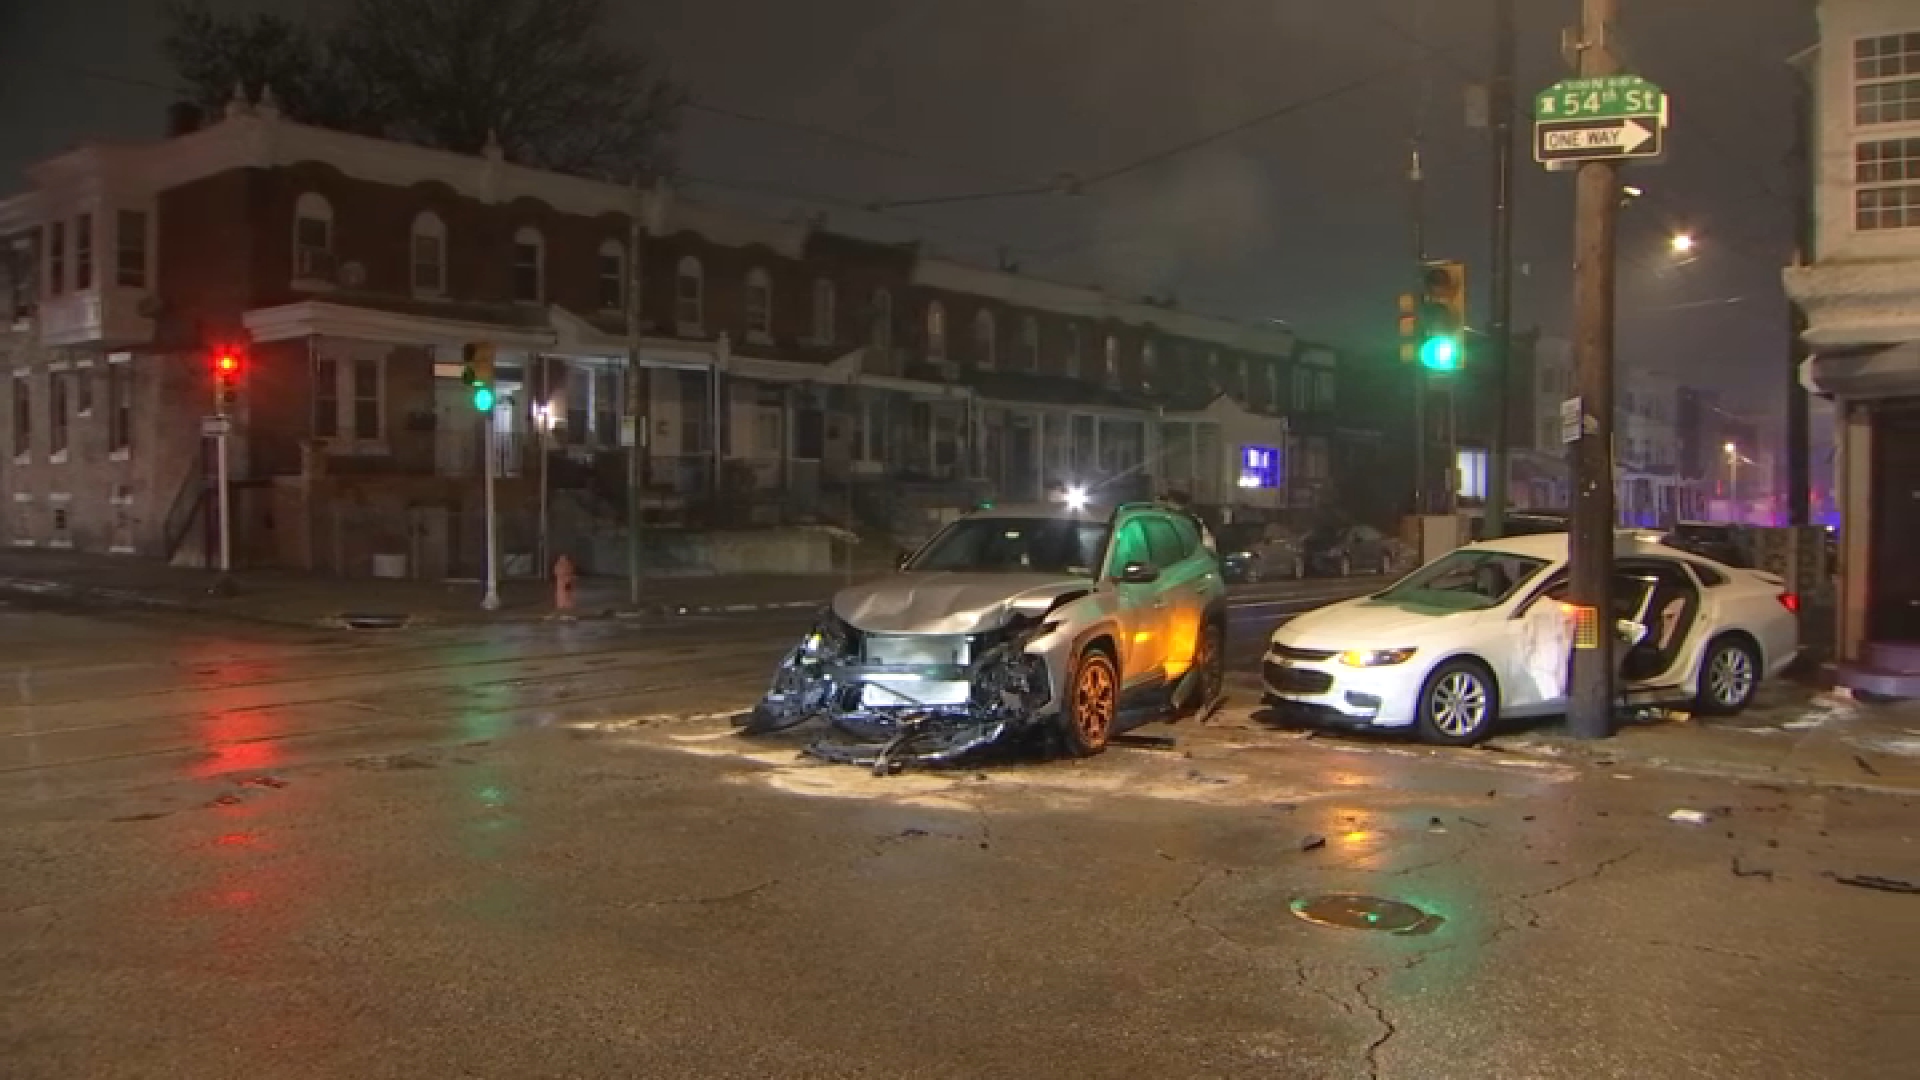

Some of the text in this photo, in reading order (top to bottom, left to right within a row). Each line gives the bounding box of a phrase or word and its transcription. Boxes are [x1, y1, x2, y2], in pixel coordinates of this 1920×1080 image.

[1626, 89, 1655, 111] St
[1548, 129, 1620, 148] ONE WAY
